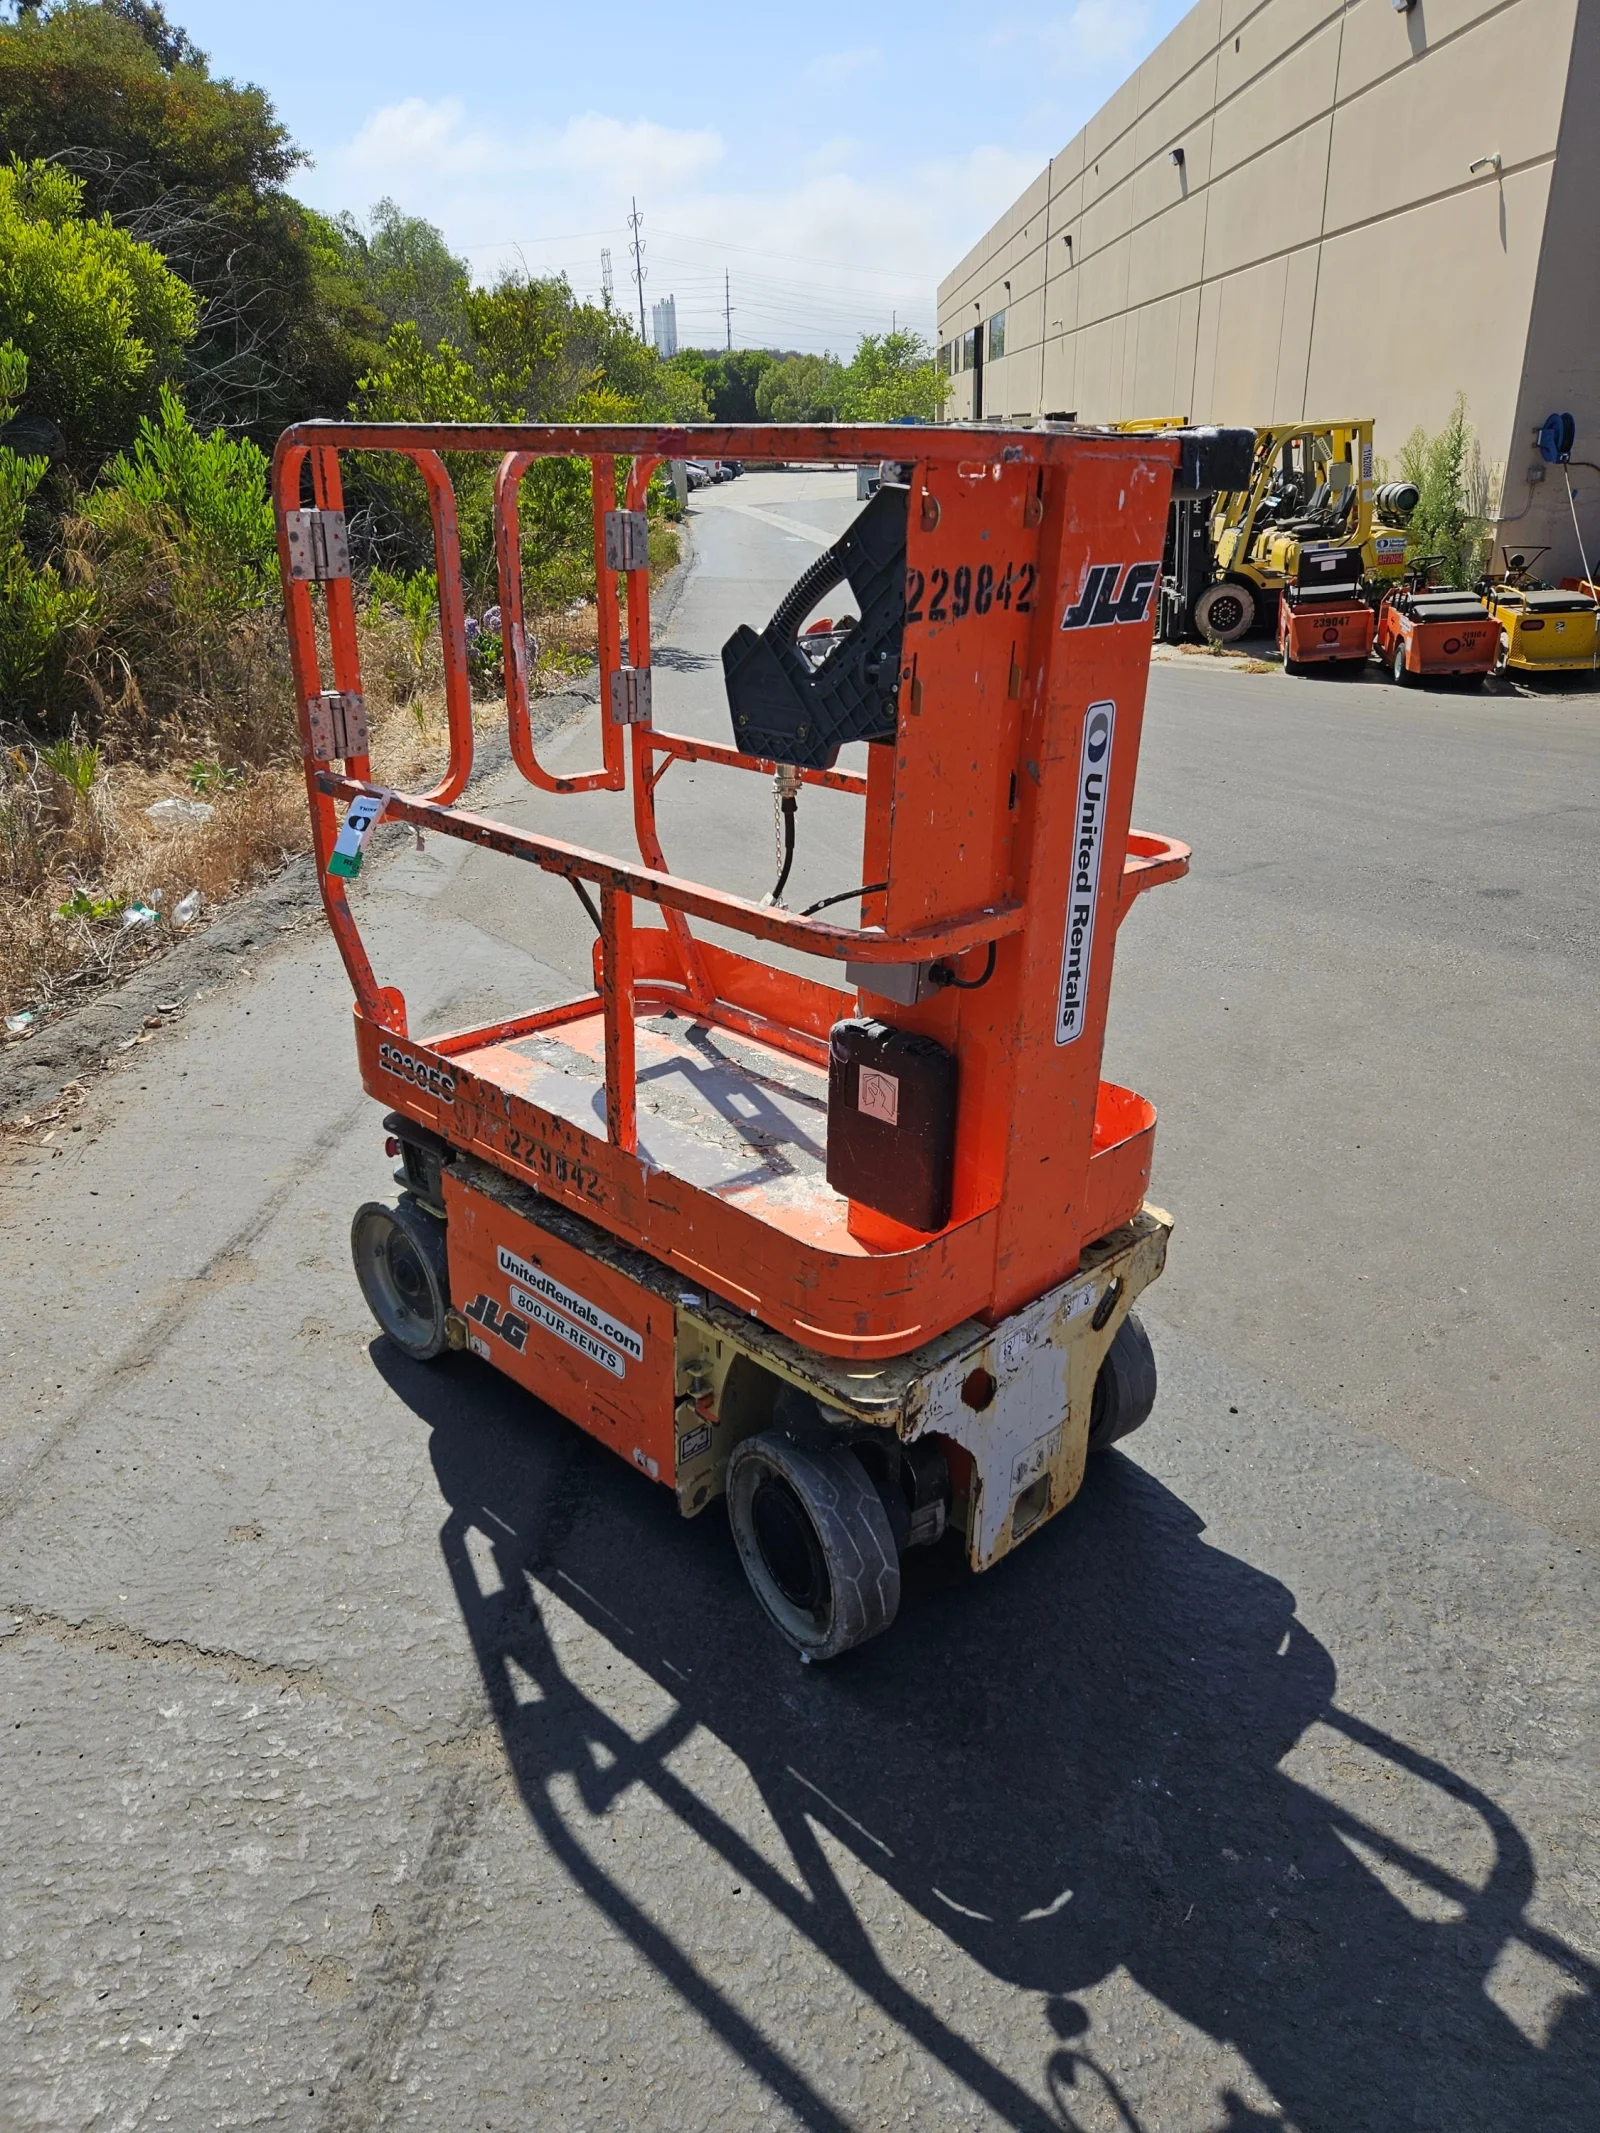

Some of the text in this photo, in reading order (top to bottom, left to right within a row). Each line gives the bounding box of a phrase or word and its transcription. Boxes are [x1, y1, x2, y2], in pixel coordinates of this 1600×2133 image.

[905, 562, 1036, 624] 229842
[1061, 562, 1160, 630] JLG
[1062, 773, 1103, 1028] United Rentals
[508, 1127, 607, 1204] 229842
[463, 1293, 529, 1354] JLG
[500, 1252, 642, 1356] UnitedRentals.com
[517, 1294, 617, 1368] 800-UR-RENTS
